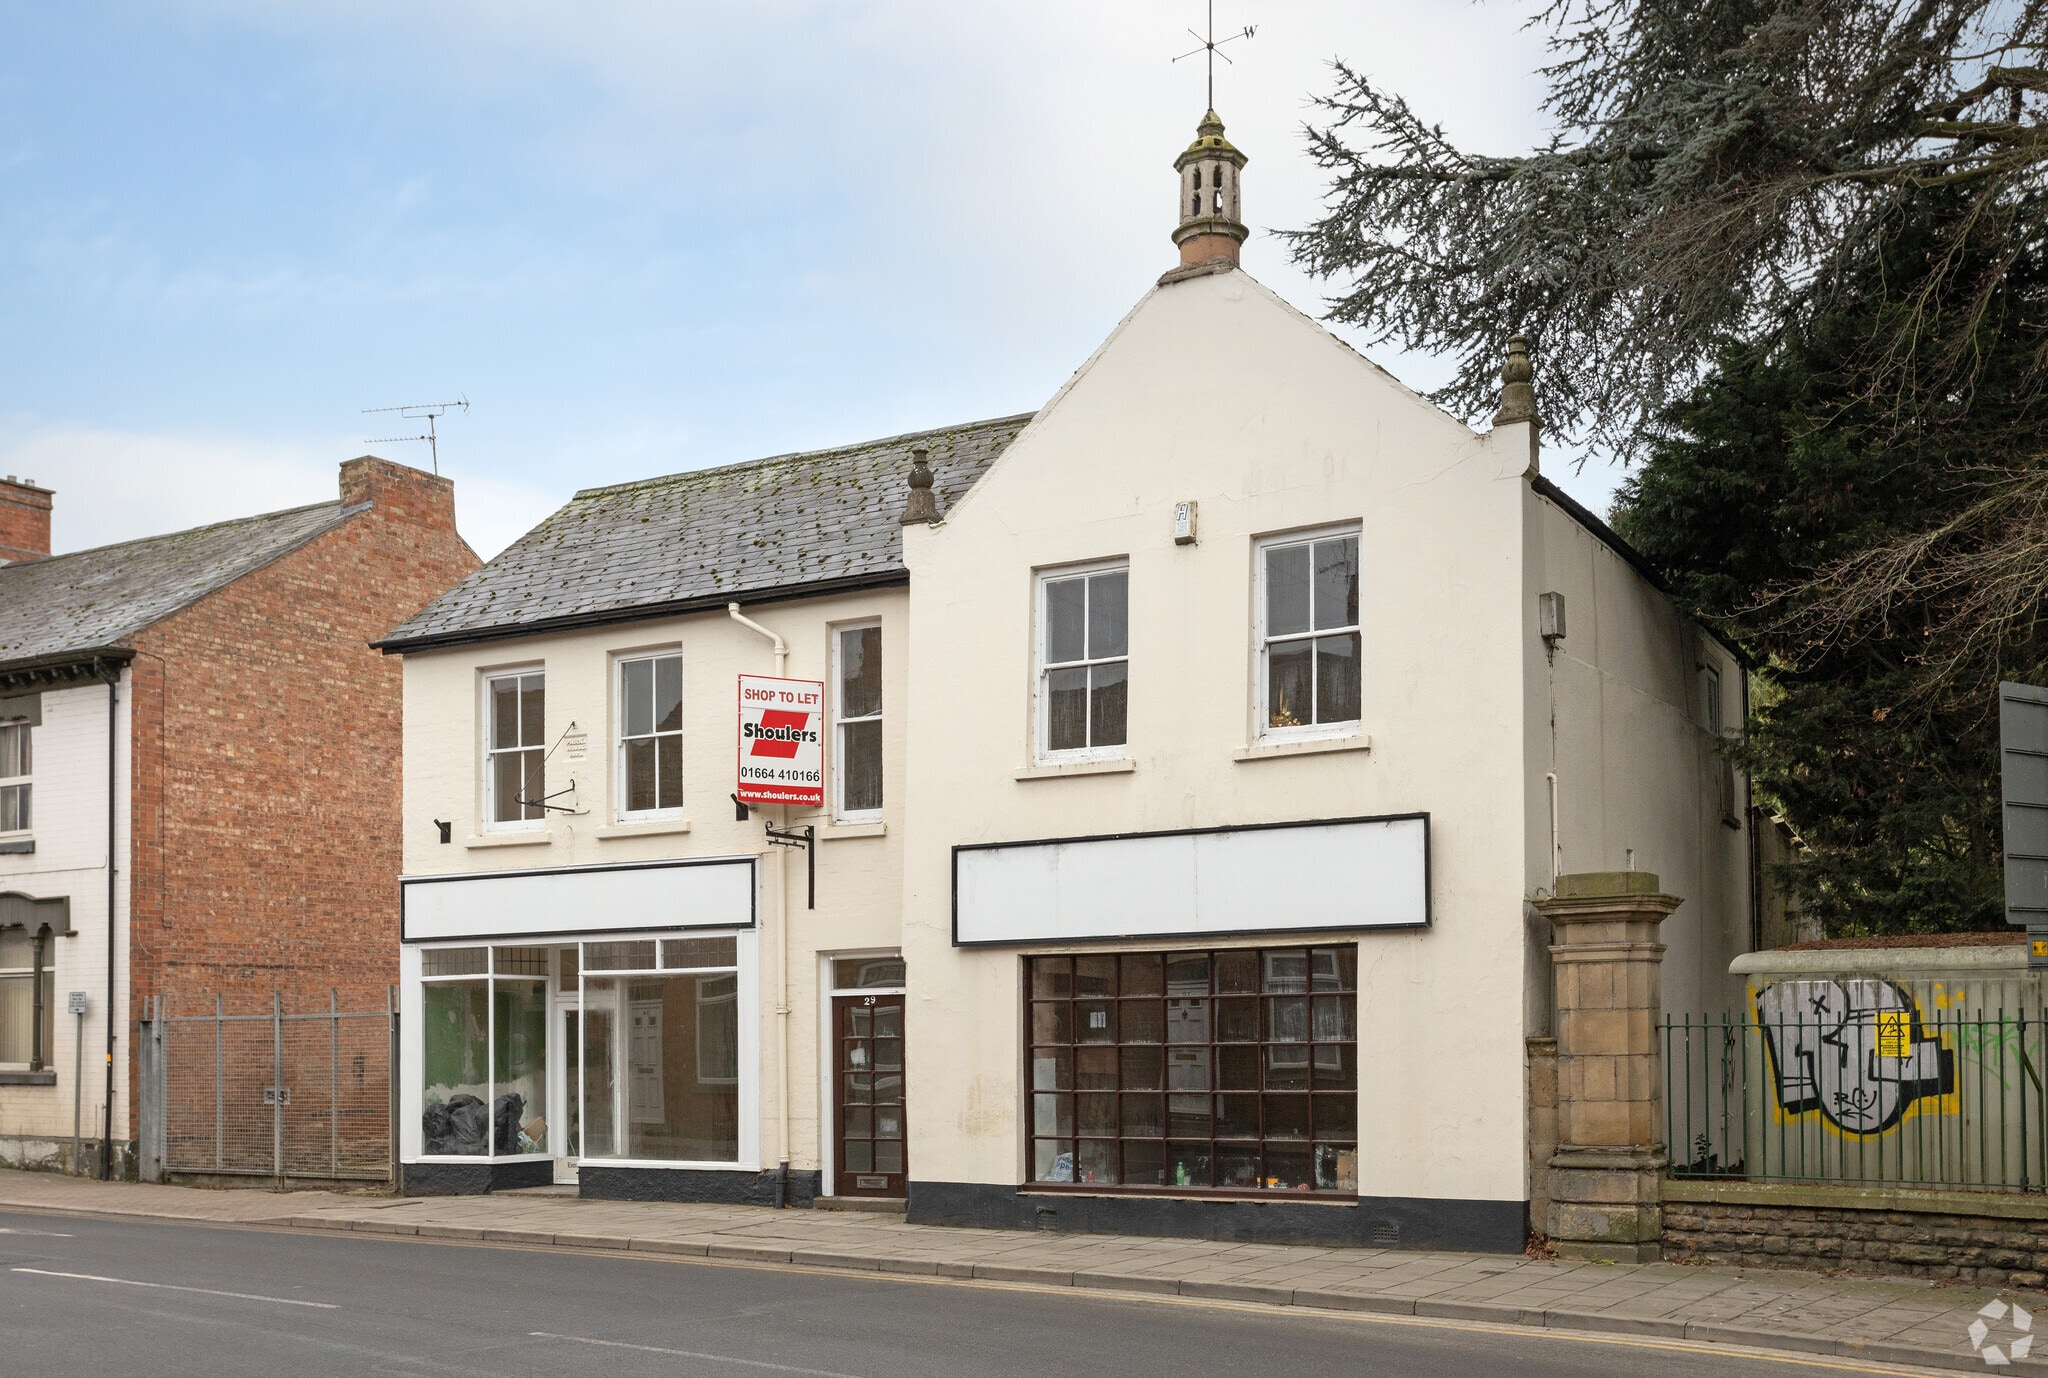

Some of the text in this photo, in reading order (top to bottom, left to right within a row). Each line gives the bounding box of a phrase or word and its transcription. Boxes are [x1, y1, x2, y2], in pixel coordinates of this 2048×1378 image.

[1243, 25, 1259, 40] W
[744, 688, 819, 705] SHOP TO LET
[743, 723, 817, 742] Shoulers
[741, 766, 820, 782] 01664 410166
[741, 790, 820, 801] www.shoulers.co.uk
[863, 996, 876, 1006] 29
